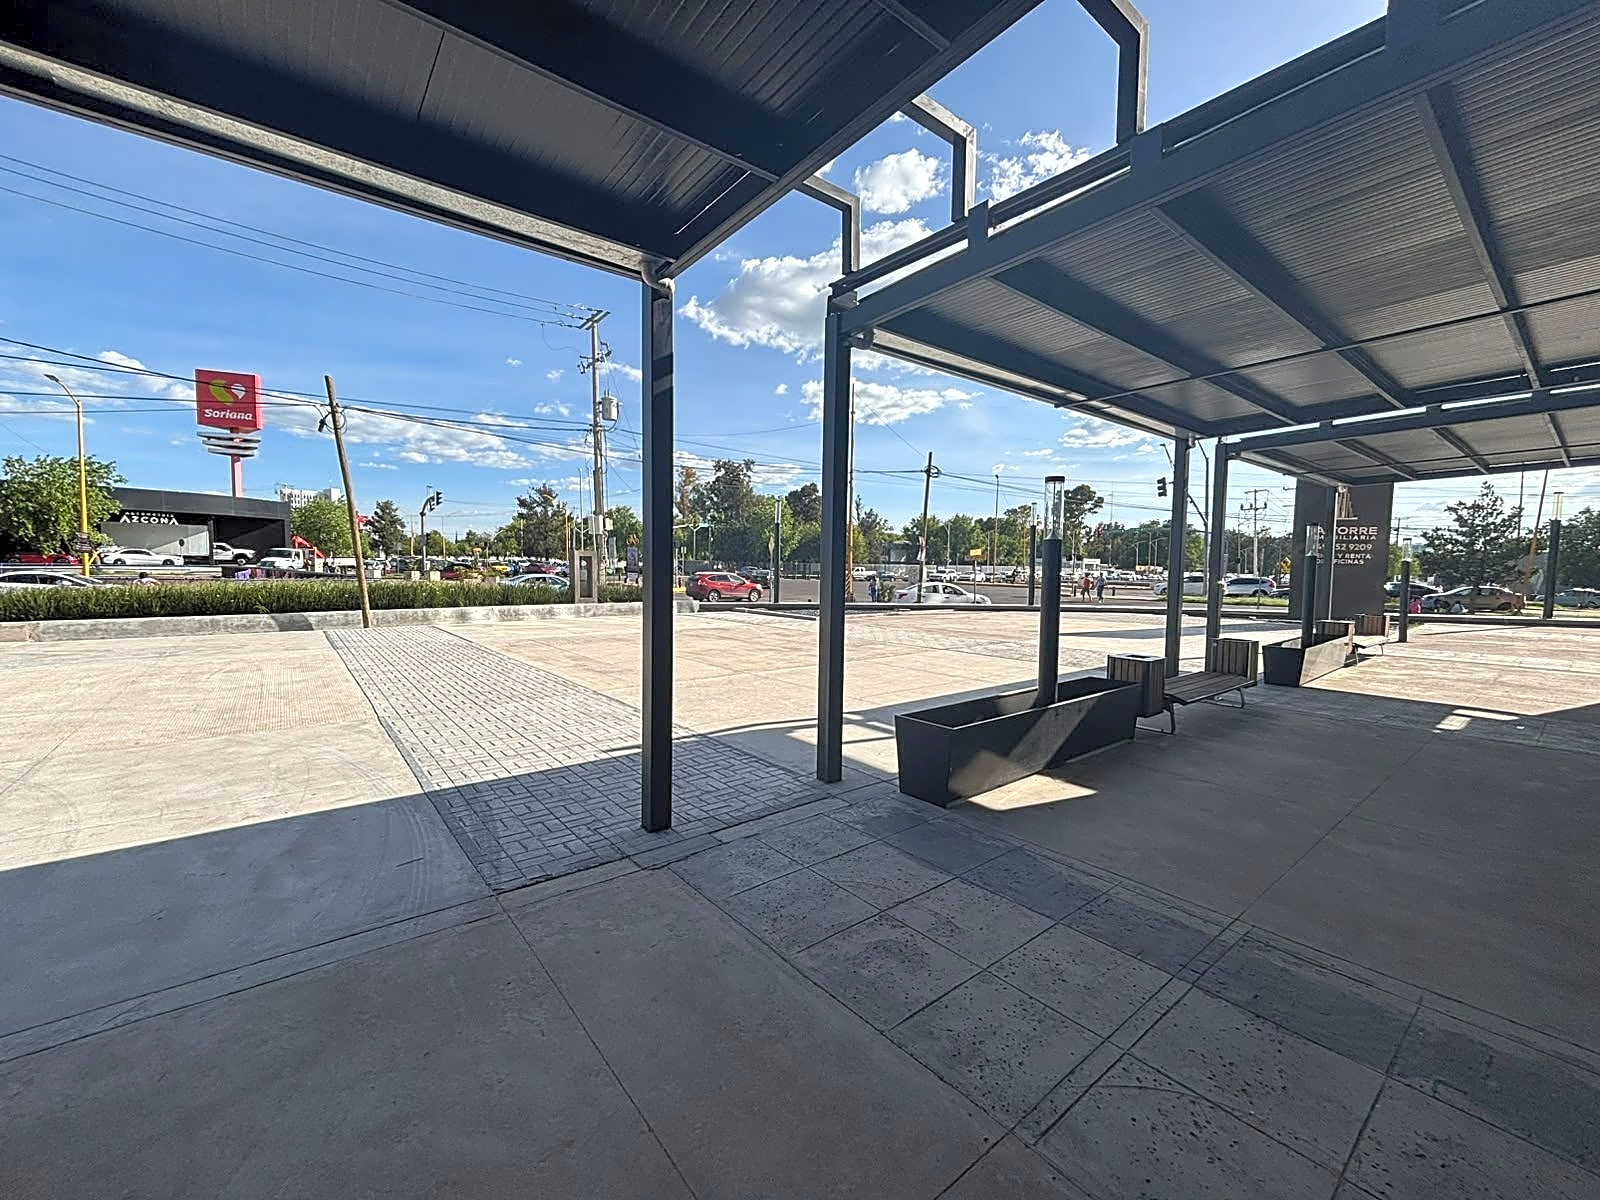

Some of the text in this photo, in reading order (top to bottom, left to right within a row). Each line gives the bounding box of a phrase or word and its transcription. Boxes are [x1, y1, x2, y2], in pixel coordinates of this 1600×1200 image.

[203, 408, 253, 420] Soriana
[120, 514, 179, 526] AZCONA
[1348, 543, 1373, 551] 9209
